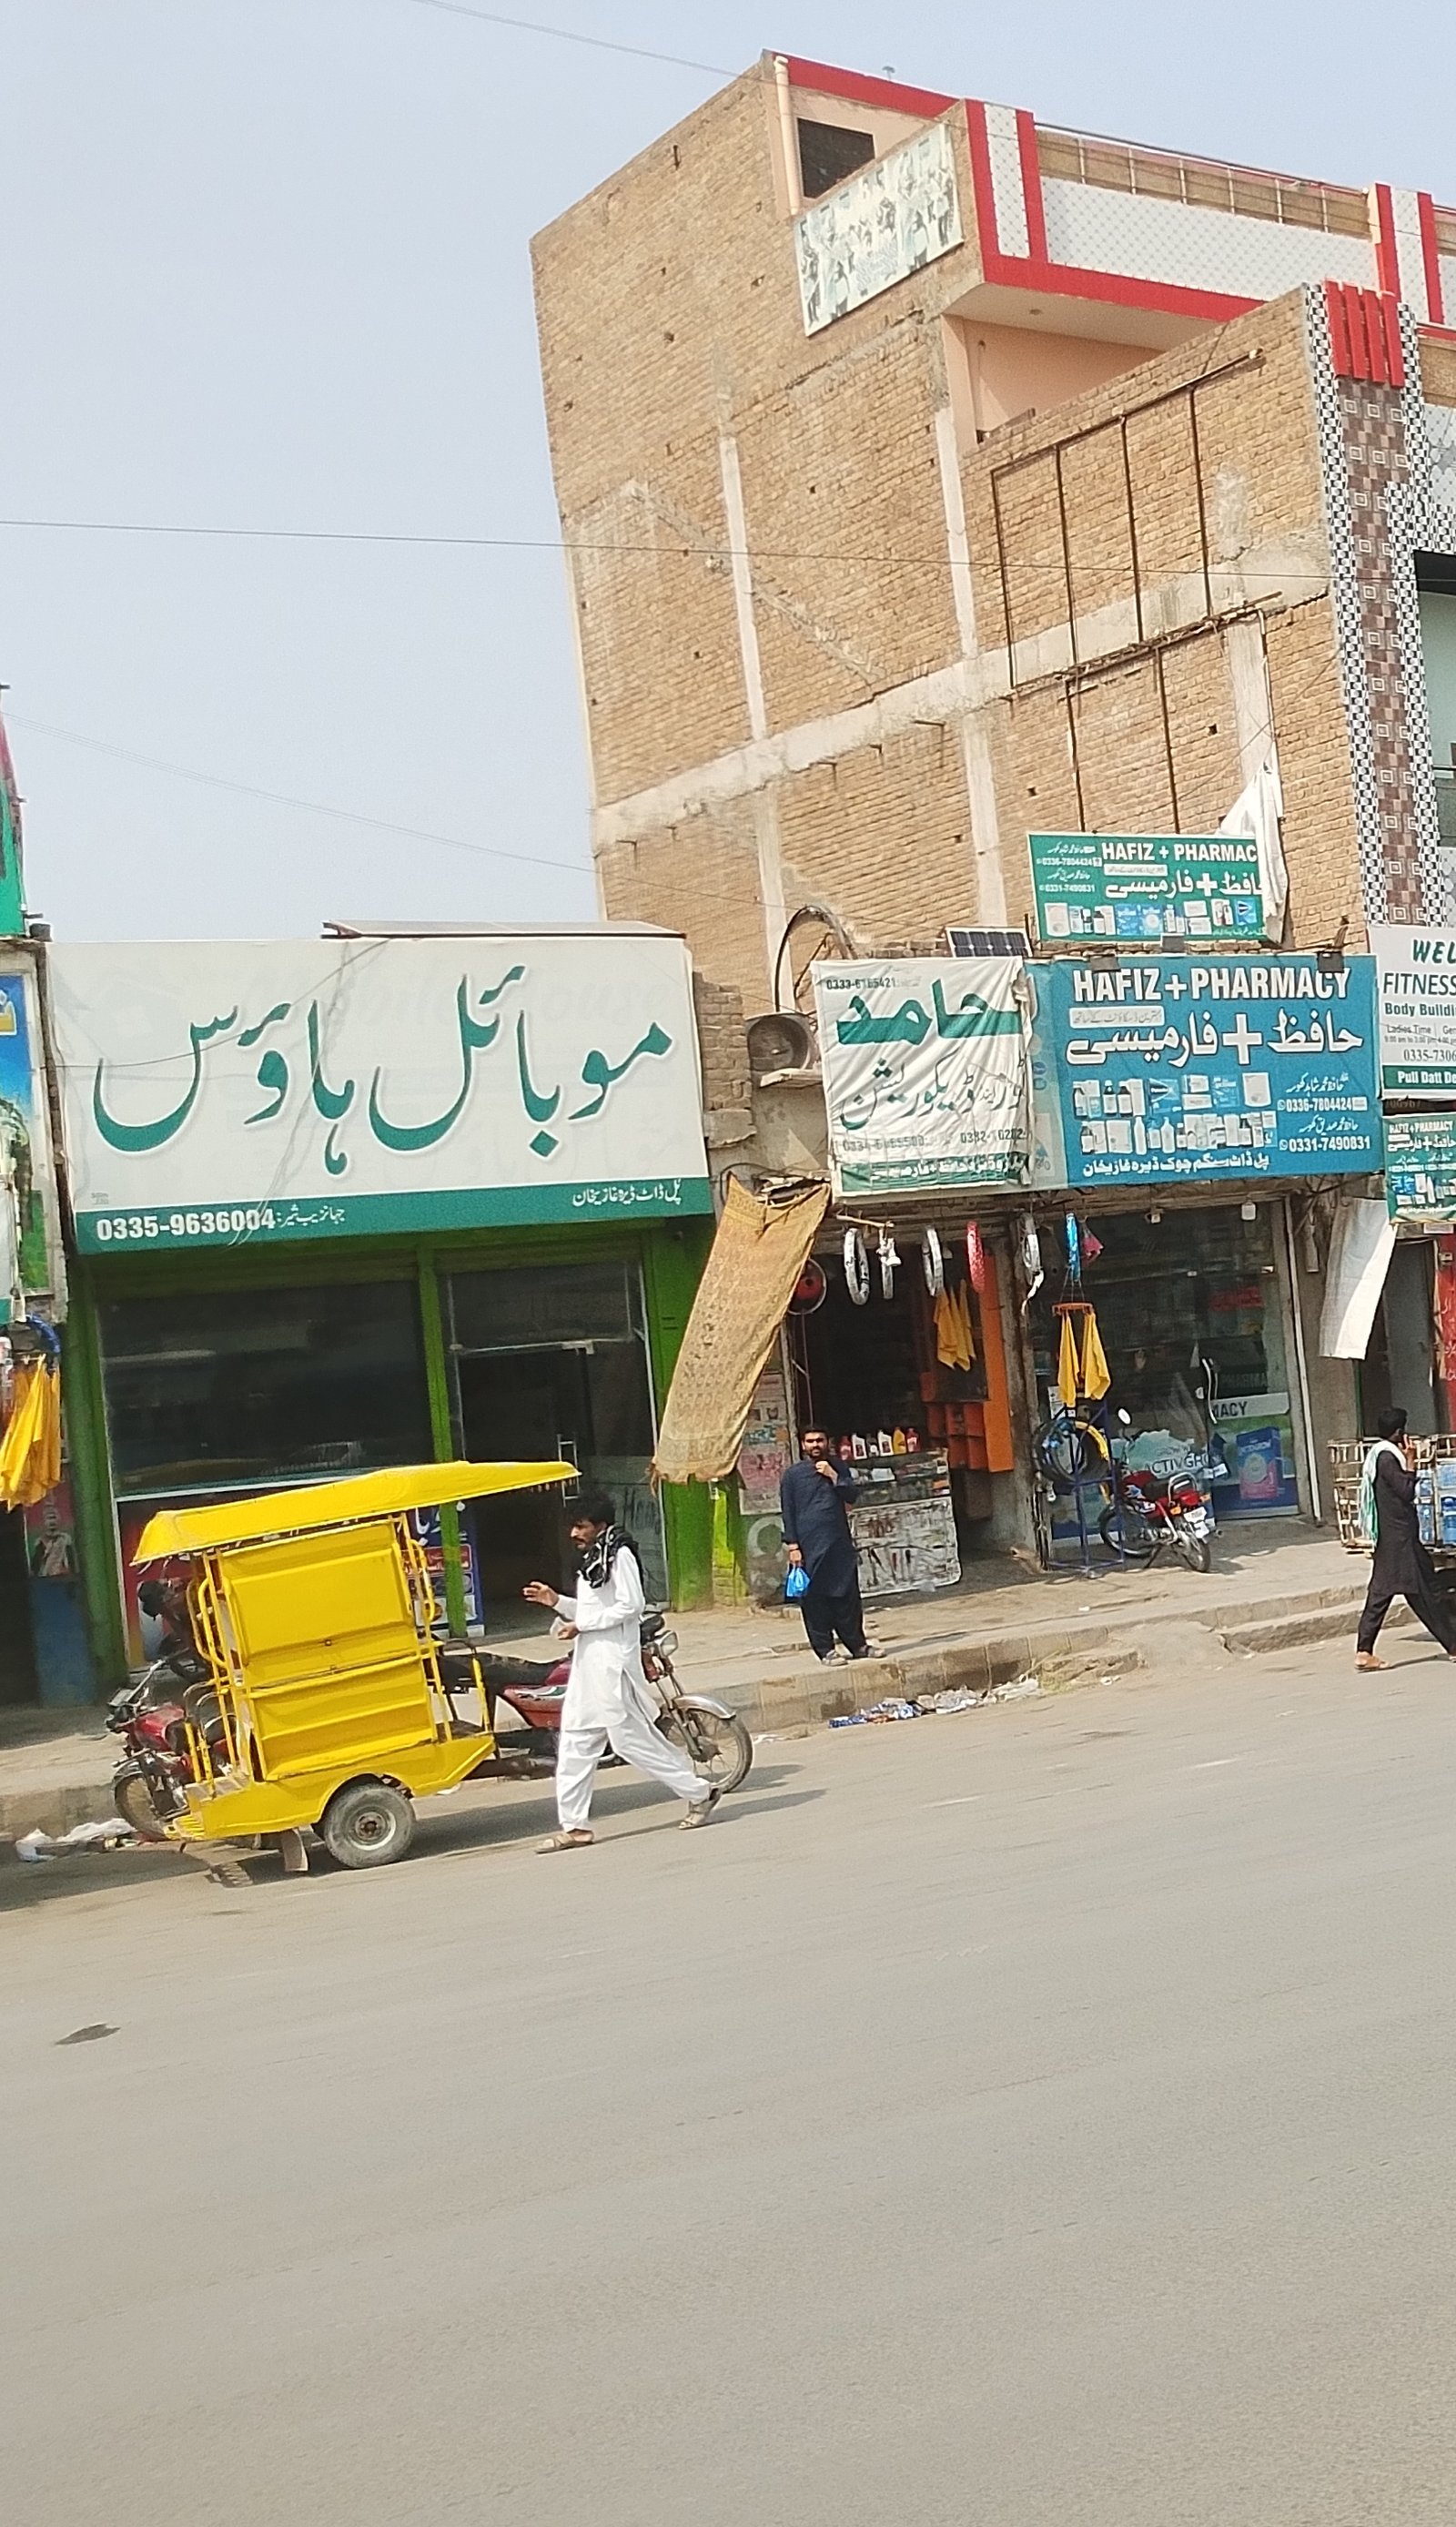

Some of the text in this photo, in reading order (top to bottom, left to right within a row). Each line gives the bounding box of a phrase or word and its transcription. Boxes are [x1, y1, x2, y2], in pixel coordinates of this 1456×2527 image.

[1102, 842, 1156, 861] HAFIZ
[1173, 844, 1258, 862] PHARMAC
[1219, 871, 1264, 896] افظ
[1073, 967, 1162, 1001] HAFIZ
[1190, 966, 1351, 1000] PHARMACY
[836, 979, 1025, 1046] حامد
[1384, 1002, 1415, 1017] Body
[1066, 1008, 1363, 1068] حافظ فارمیسی
[1412, 1024, 1431, 1034] Time
[369, 965, 672, 1157] موبائل
[1397, 1071, 1419, 1084] Pull
[1286, 1097, 1352, 1112] 0336-7804424
[1414, 1121, 1453, 1132] PHARMACY
[1289, 1135, 1370, 1152] 0331-7490831
[96, 1207, 276, 1241] 0335-9636004
